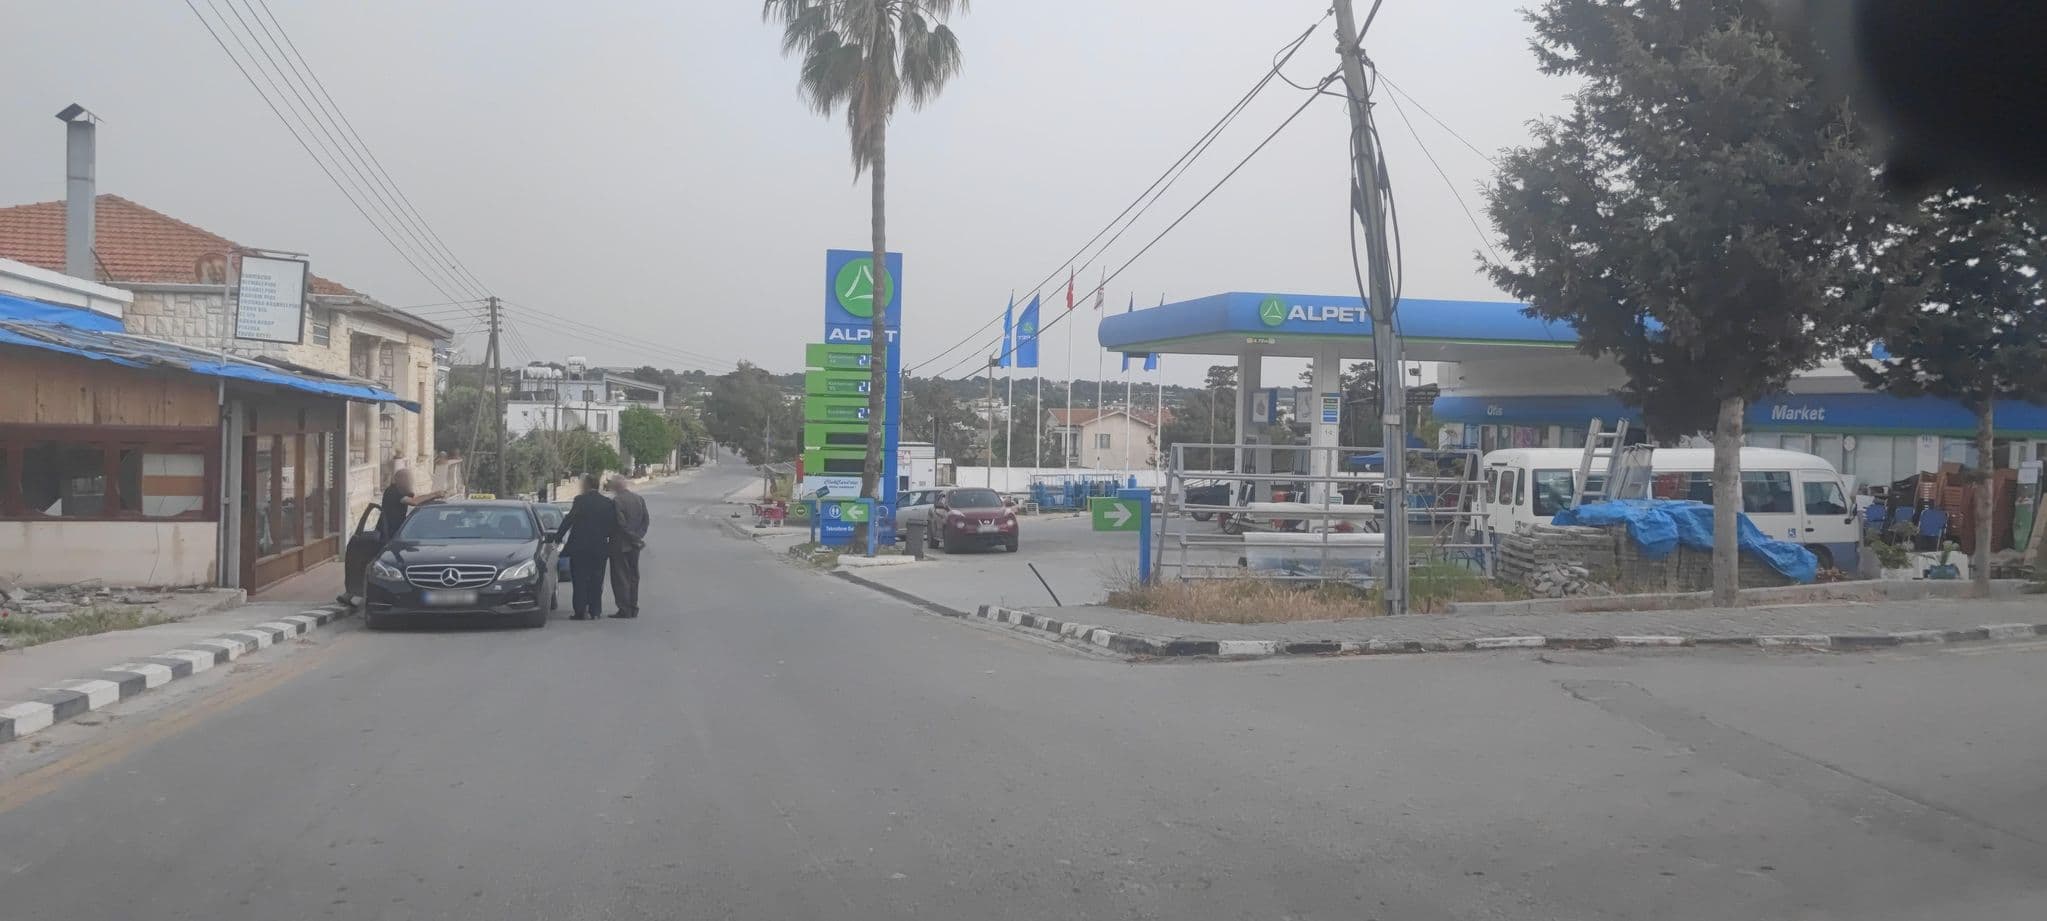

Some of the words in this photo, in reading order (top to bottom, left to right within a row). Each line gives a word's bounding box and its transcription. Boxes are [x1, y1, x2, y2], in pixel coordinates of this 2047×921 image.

[1287, 305, 1367, 322] ALPET
[828, 328, 898, 342] ALPT
[1771, 405, 1825, 420] Market
